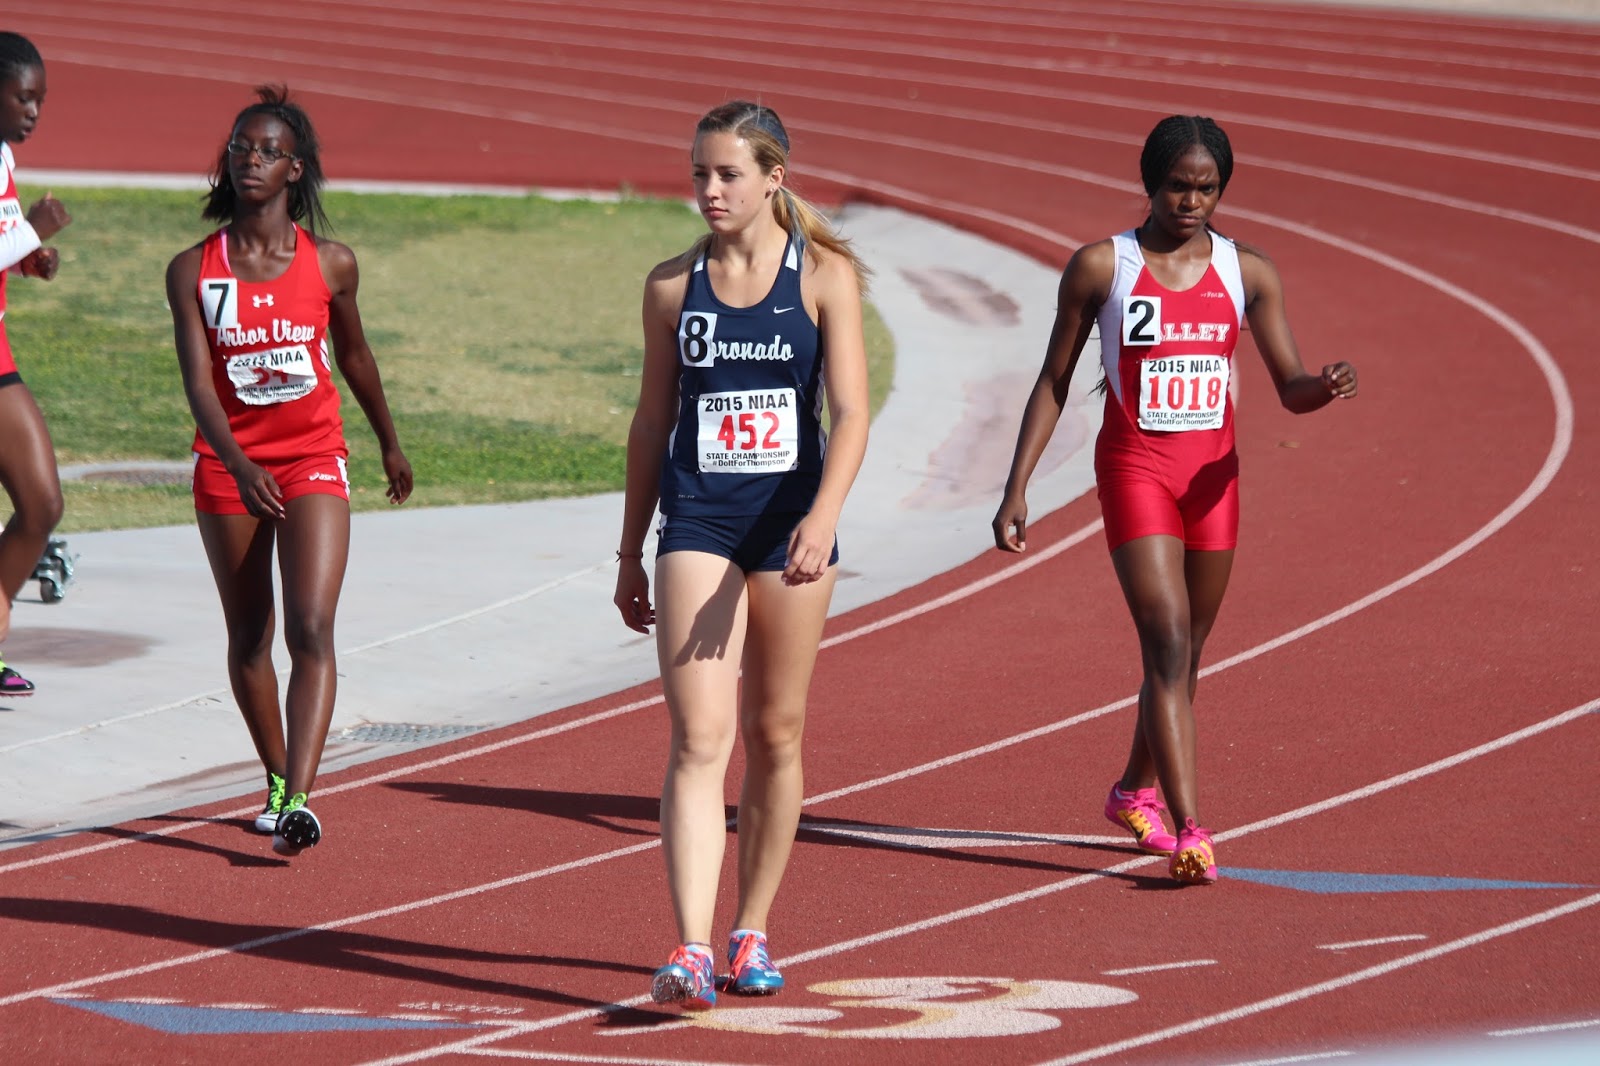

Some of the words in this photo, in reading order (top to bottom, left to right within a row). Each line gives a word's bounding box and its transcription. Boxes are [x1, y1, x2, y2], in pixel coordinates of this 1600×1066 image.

[209, 283, 230, 327] 7
[216, 323, 270, 347] Arbor
[272, 318, 315, 343] View
[1129, 300, 1155, 342] 2
[683, 315, 709, 363] 8
[270, 350, 304, 366] NIAA
[1148, 360, 1185, 373] 2015
[1190, 359, 1222, 373] NIAA
[705, 396, 743, 412] 2015
[748, 393, 788, 410] NIAA
[1147, 375, 1222, 411] 1018
[1147, 411, 1169, 419] STATE
[1170, 410, 1219, 419] CHAMPIONSHIP
[717, 411, 780, 450] 452
[706, 452, 730, 460] STATE
[731, 450, 790, 460] CHAMPIONSHIP
